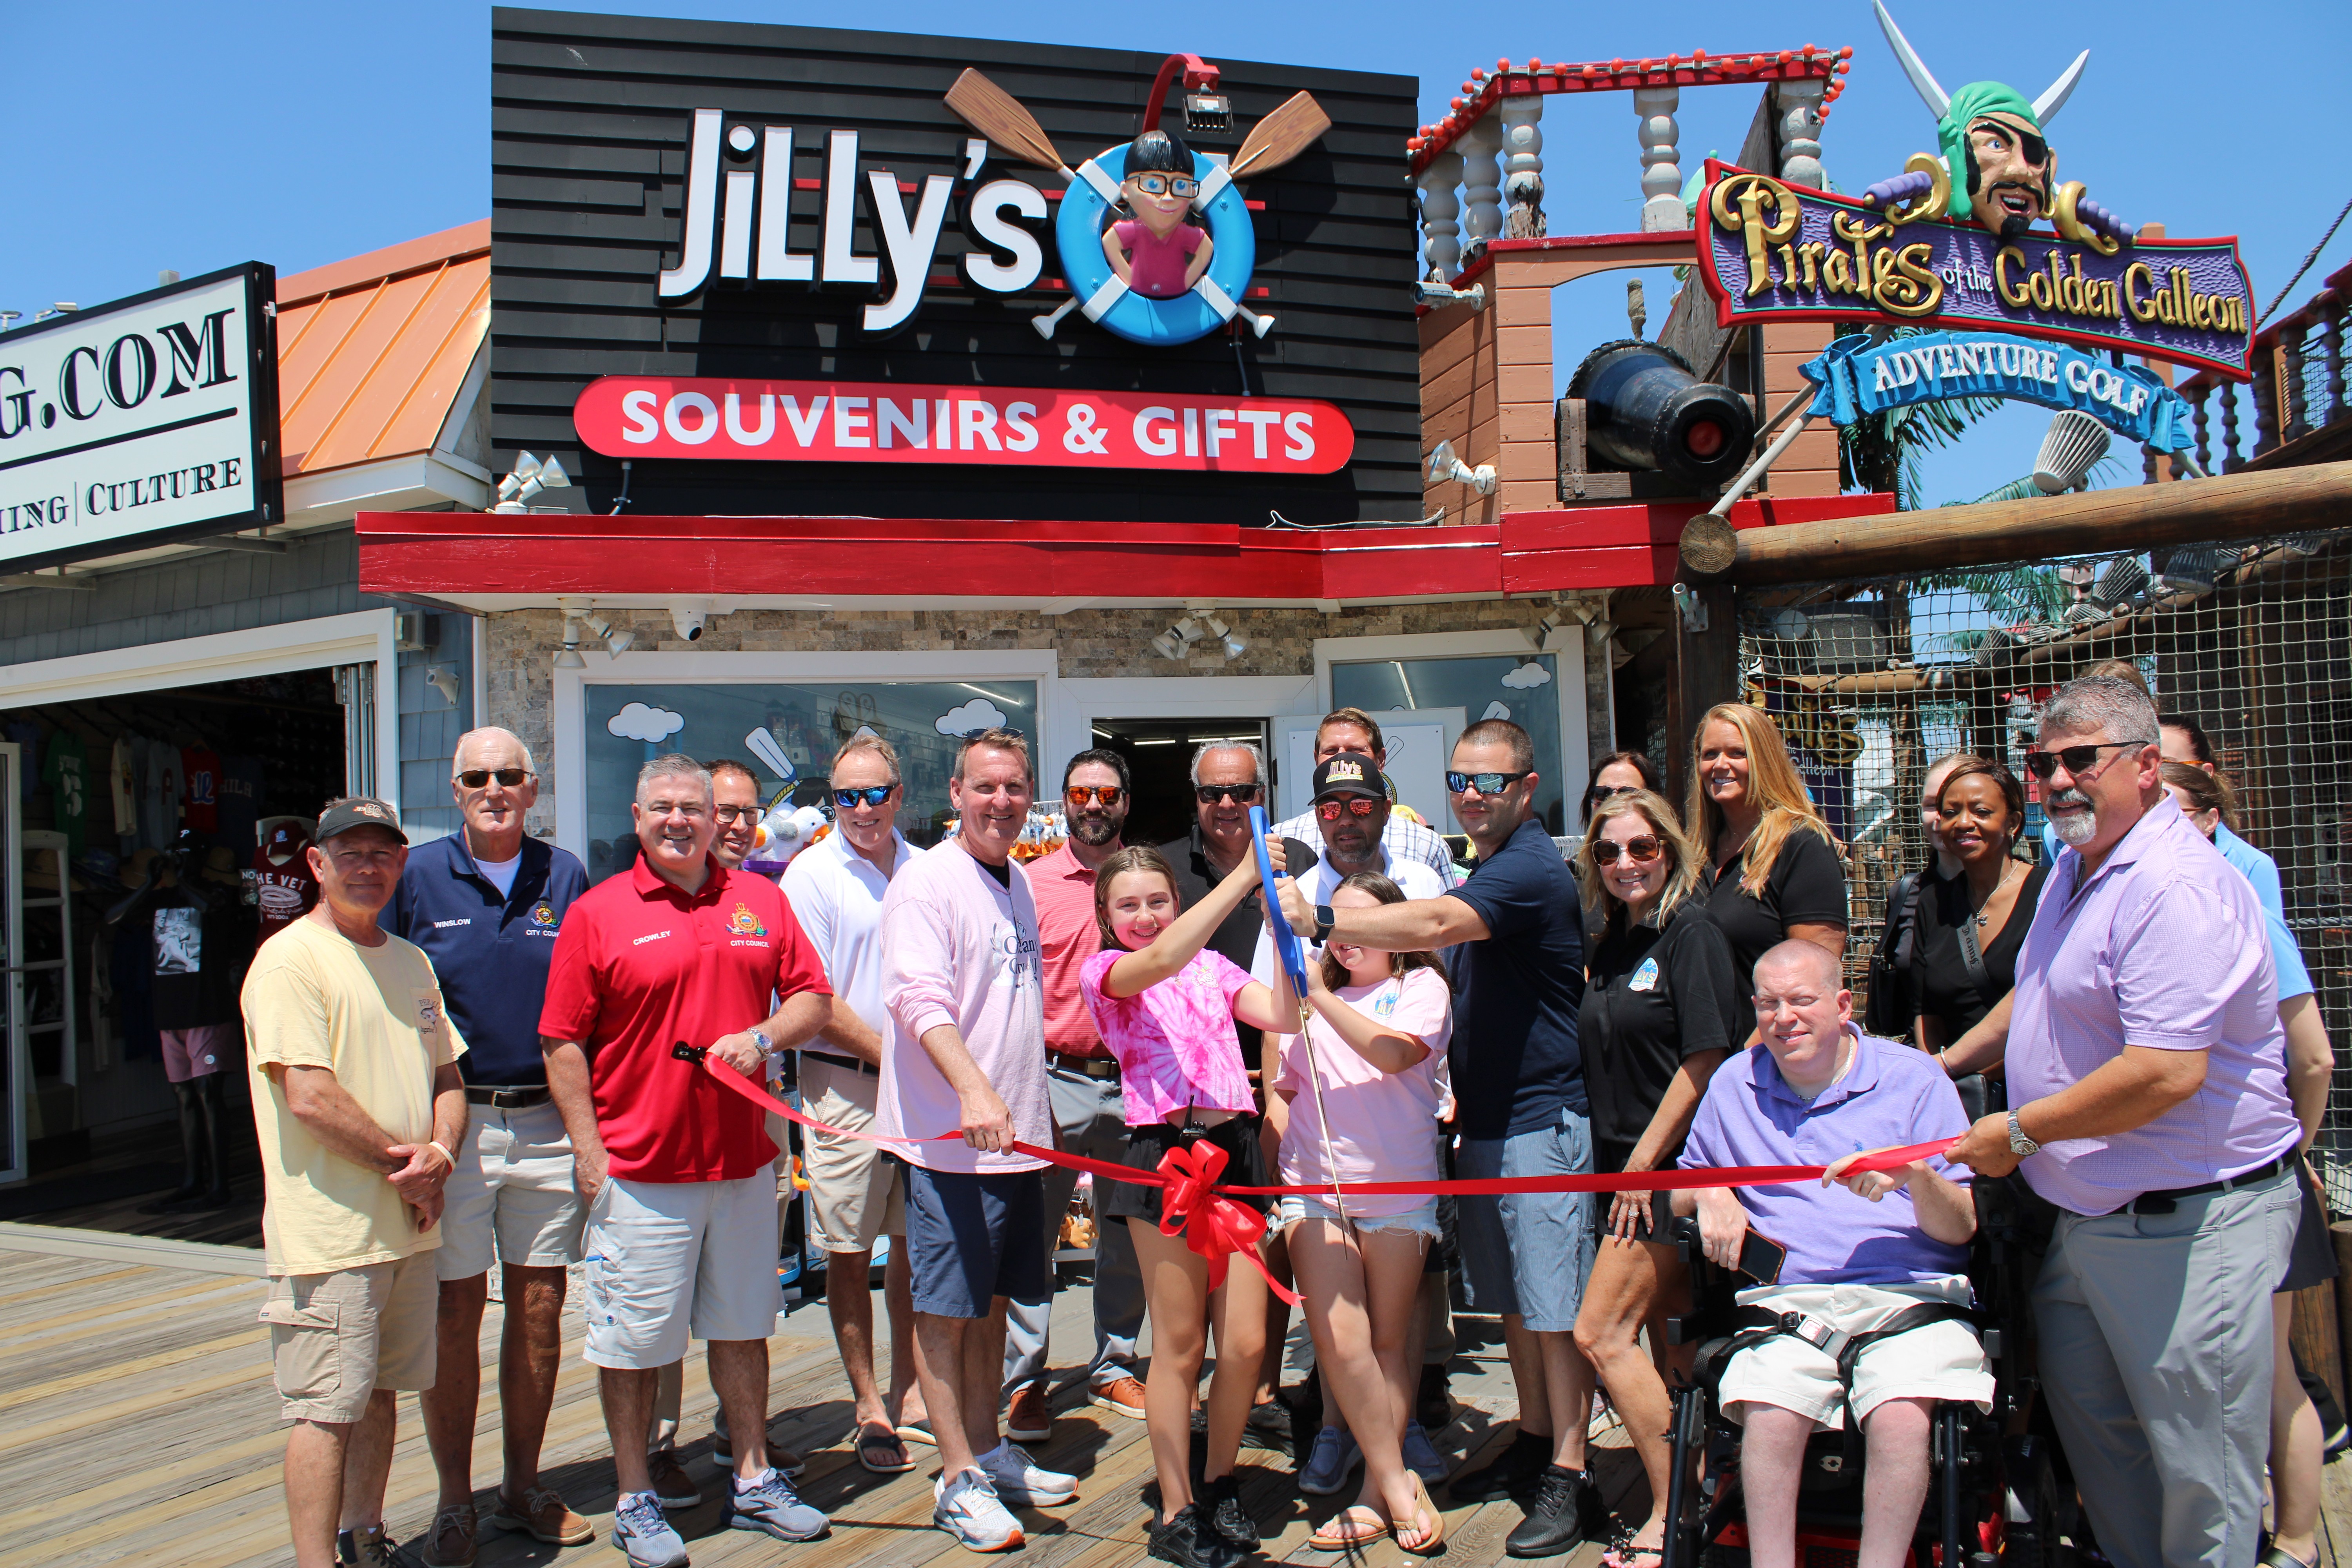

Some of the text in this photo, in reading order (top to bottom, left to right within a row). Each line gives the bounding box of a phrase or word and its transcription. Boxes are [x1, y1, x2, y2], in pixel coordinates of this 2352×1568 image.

[1711, 174, 2247, 334] Pirates of the Golden Galleon
[1874, 342, 2149, 417] ADVENTURE GOLF
[621, 389, 1316, 461] SOUVENIRS & GIFTS
[256, 873, 307, 891] HE VET
[434, 918, 471, 929] WINSLOW
[633, 930, 671, 946] CROWLEY
[746, 940, 770, 948] COUNCIL
